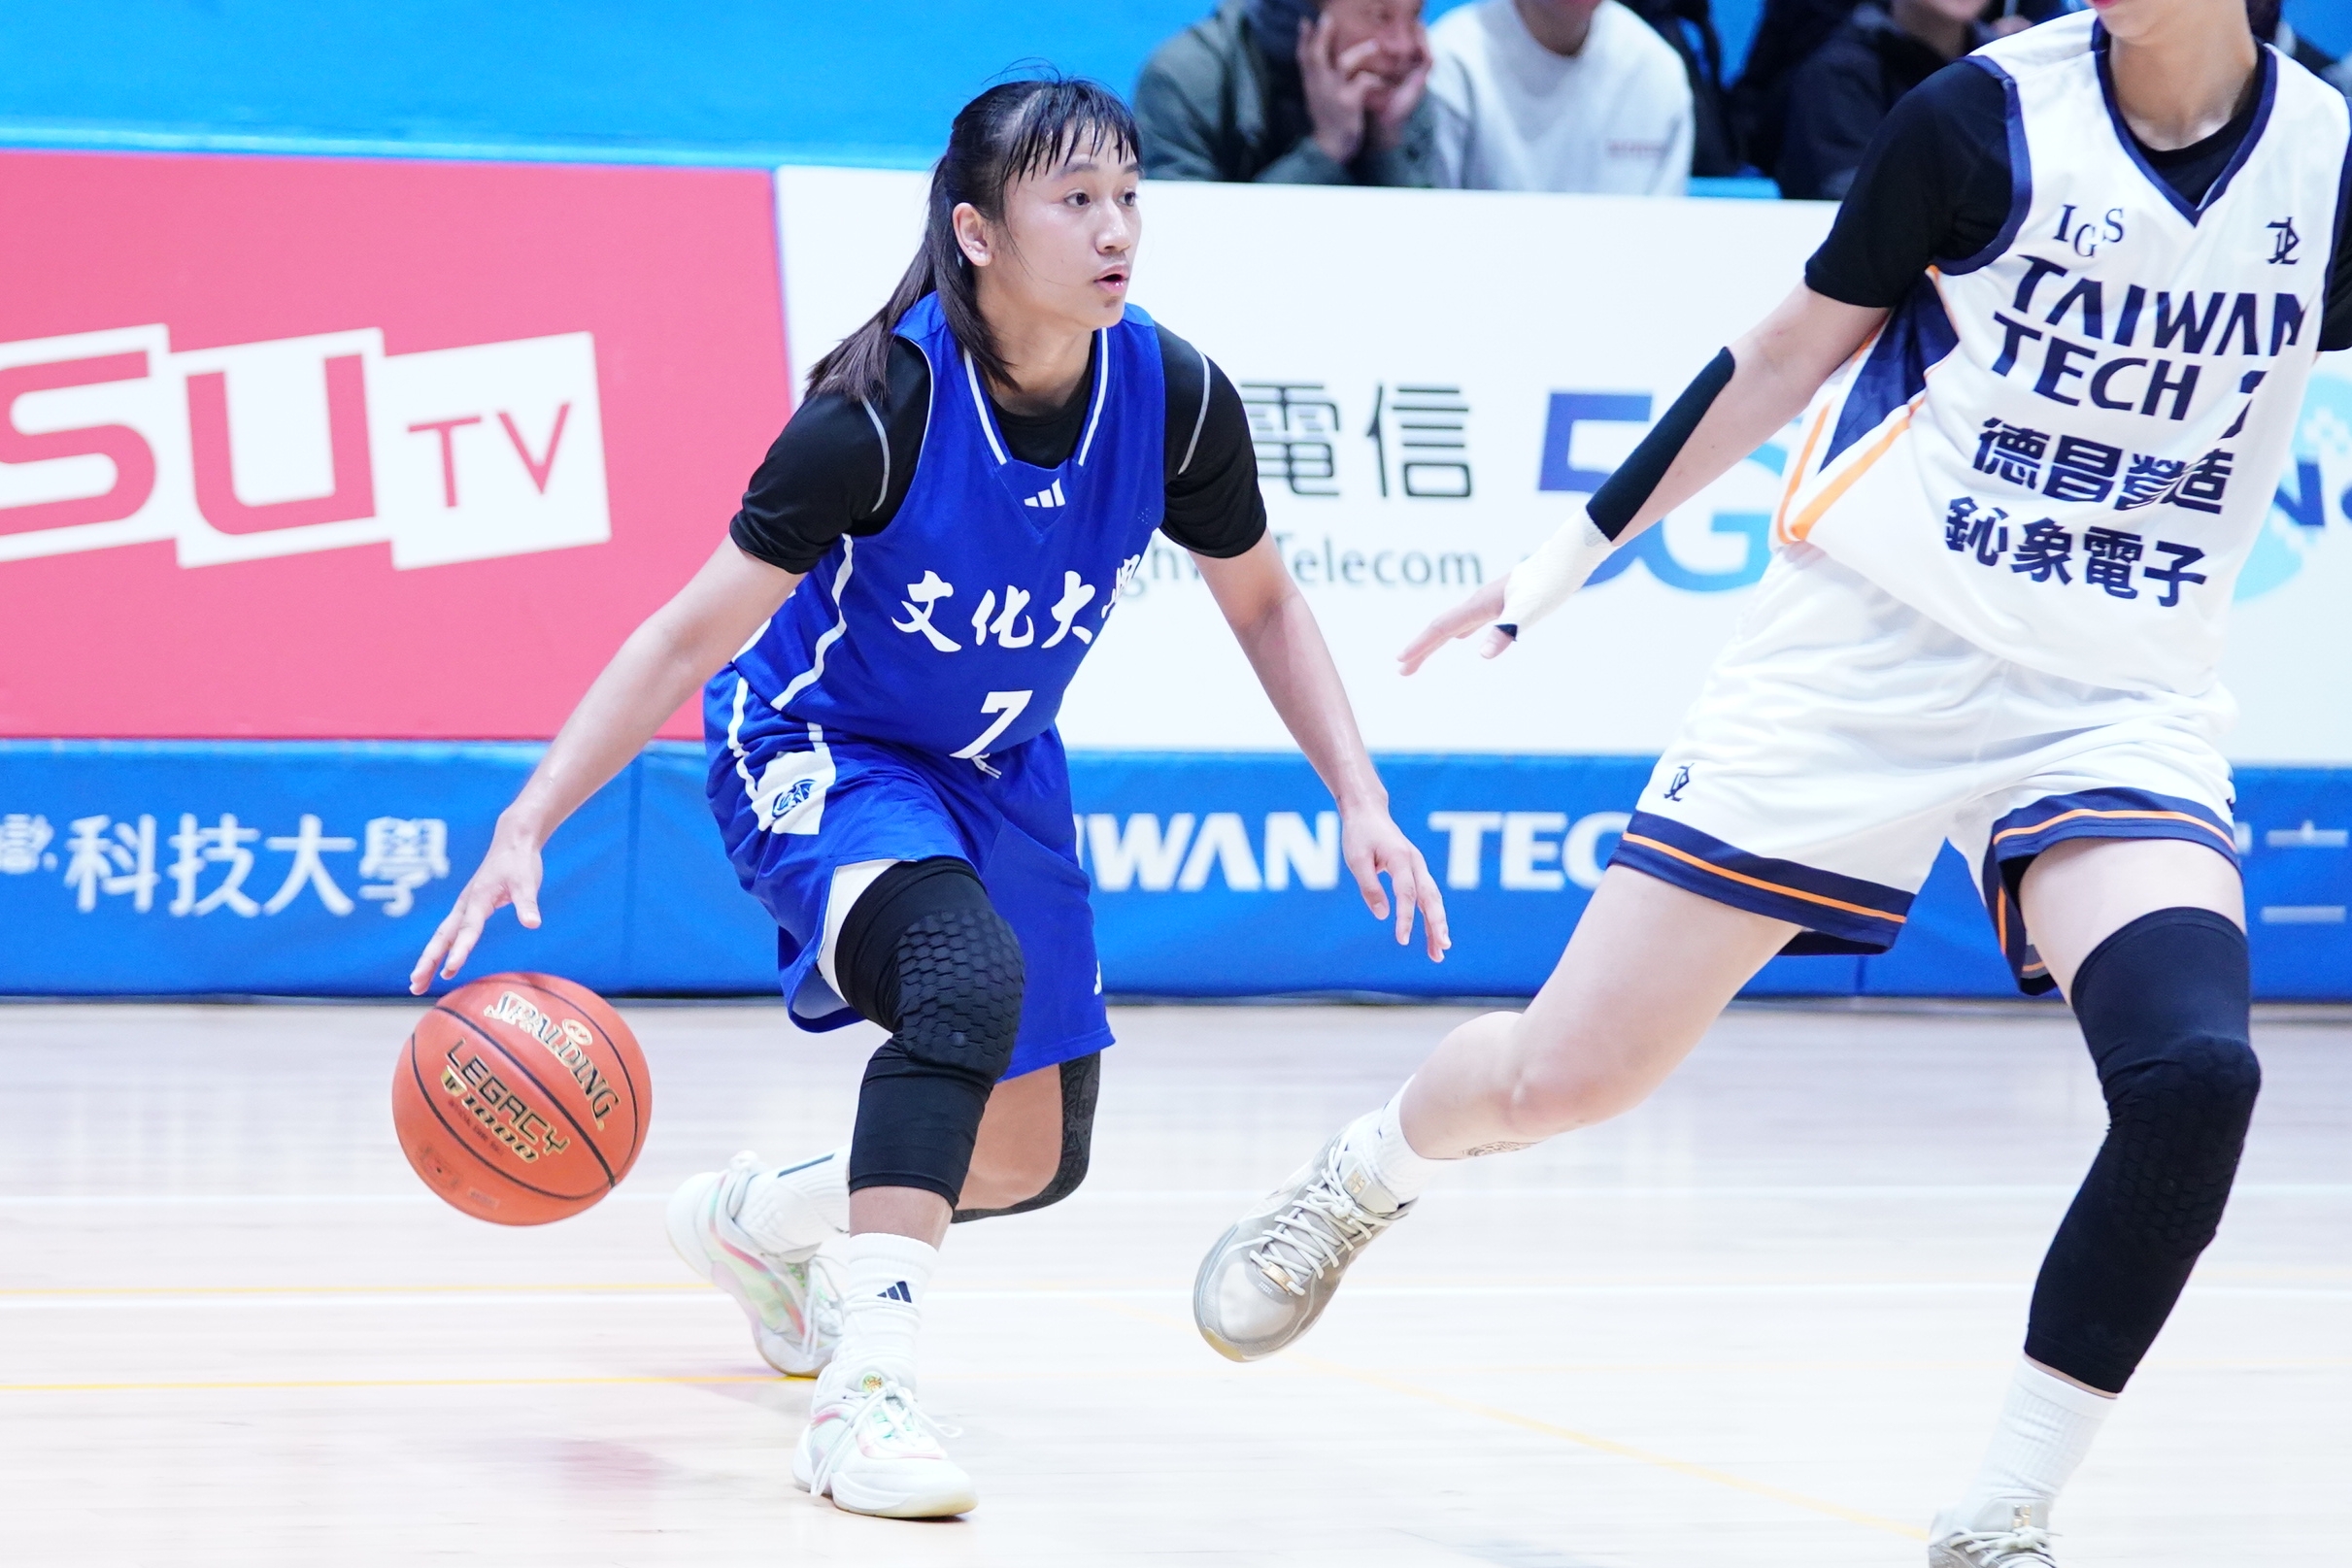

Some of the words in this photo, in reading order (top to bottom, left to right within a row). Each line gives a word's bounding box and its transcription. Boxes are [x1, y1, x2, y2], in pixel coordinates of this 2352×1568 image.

[2052, 203, 2126, 259] IGS
[1991, 312, 2201, 421] TECH
[407, 401, 571, 509] TV
[1239, 383, 1472, 498] 電信
[1971, 417, 2236, 515] 德昌營造
[1944, 495, 2208, 609] 鈊象電子
[949, 689, 1033, 759] 7
[1072, 811, 1341, 891] WAN
[1427, 810, 1631, 891] TEC
[445, 1038, 571, 1156] LEGACY
[484, 991, 620, 1131] SPALDING
